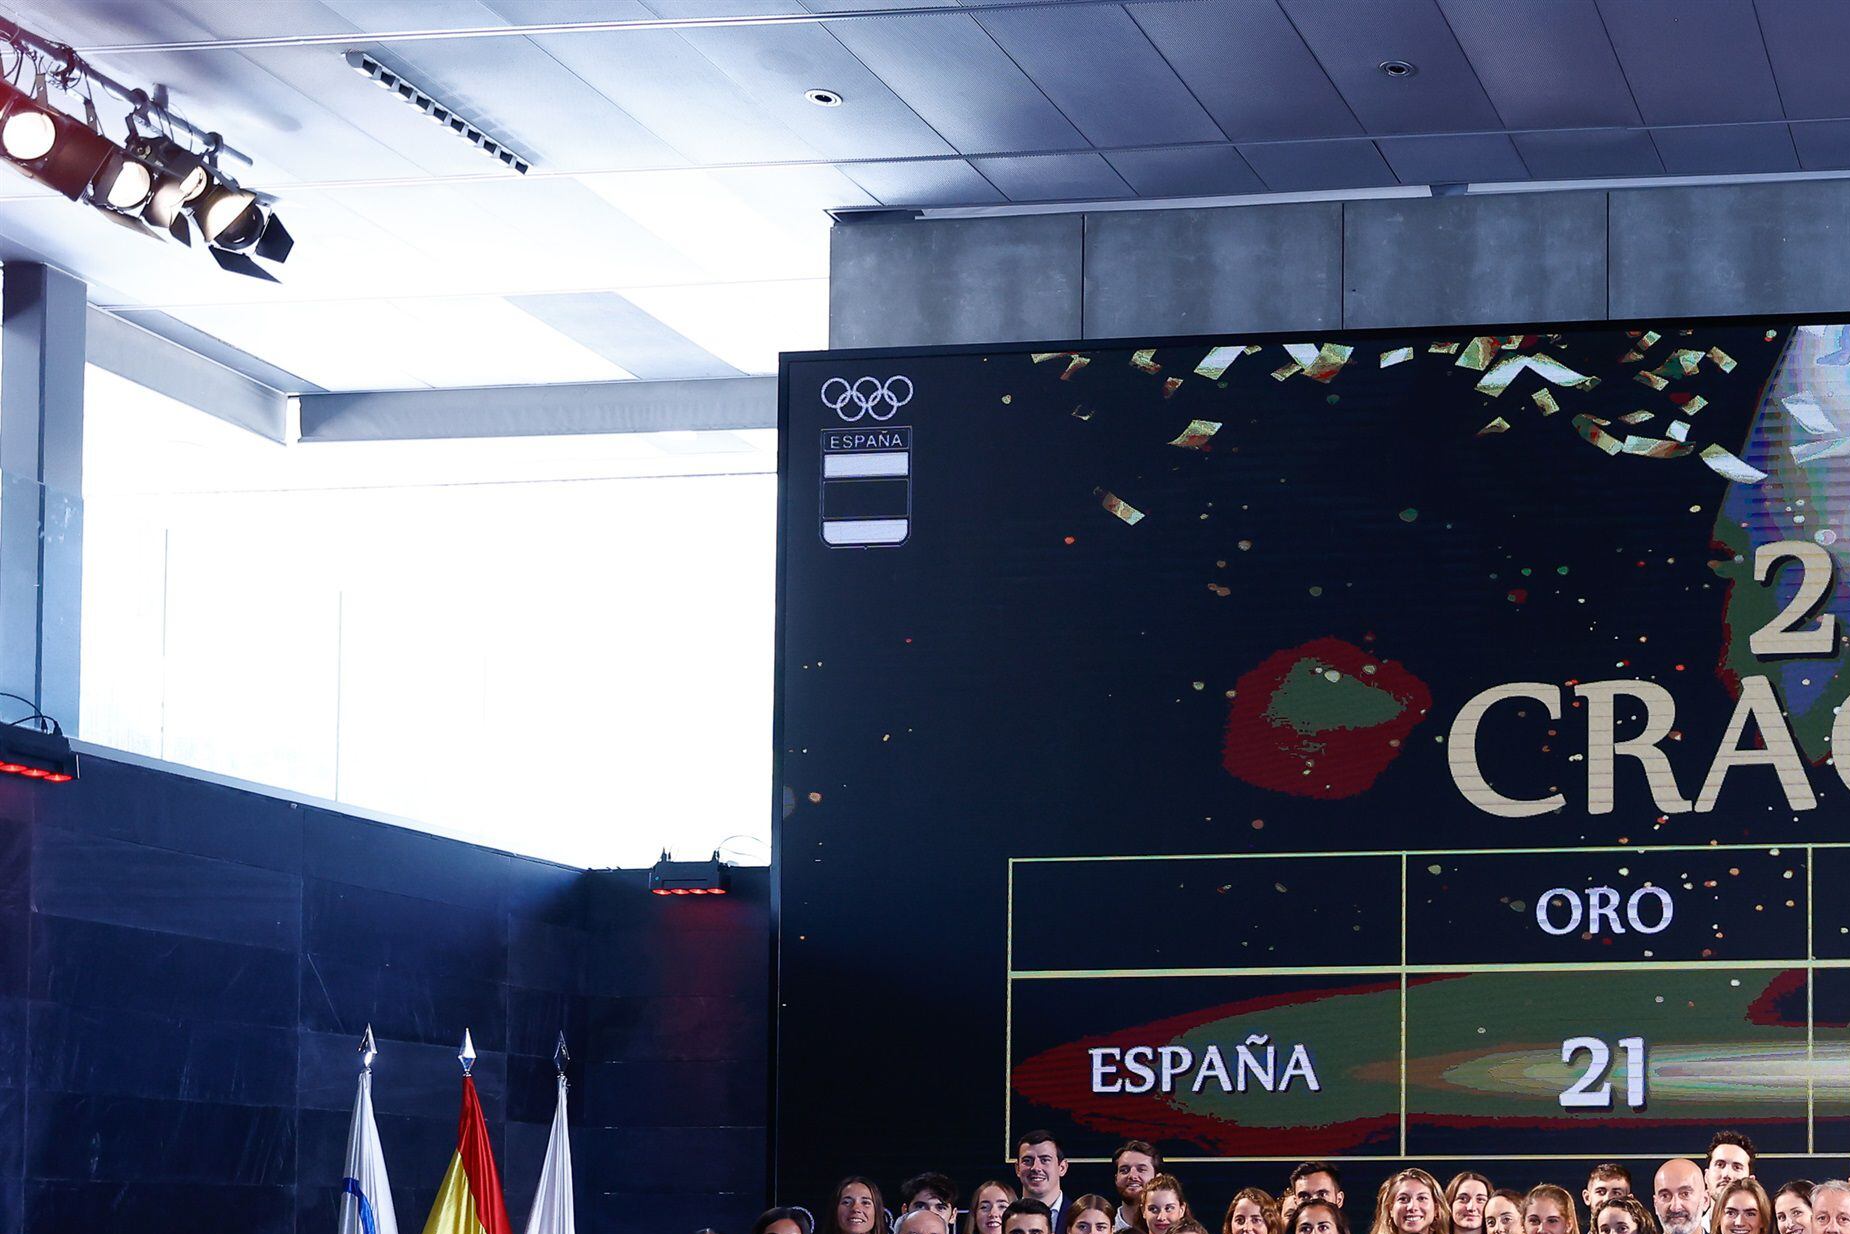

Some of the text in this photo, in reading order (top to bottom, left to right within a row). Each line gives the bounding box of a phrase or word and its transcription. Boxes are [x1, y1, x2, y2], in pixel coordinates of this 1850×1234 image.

[830, 431, 902, 449] ESPAÑA
[1535, 886, 1675, 936] ORO
[1088, 1034, 1320, 1095] ESPAÑA
[1558, 1037, 1647, 1109] 21
